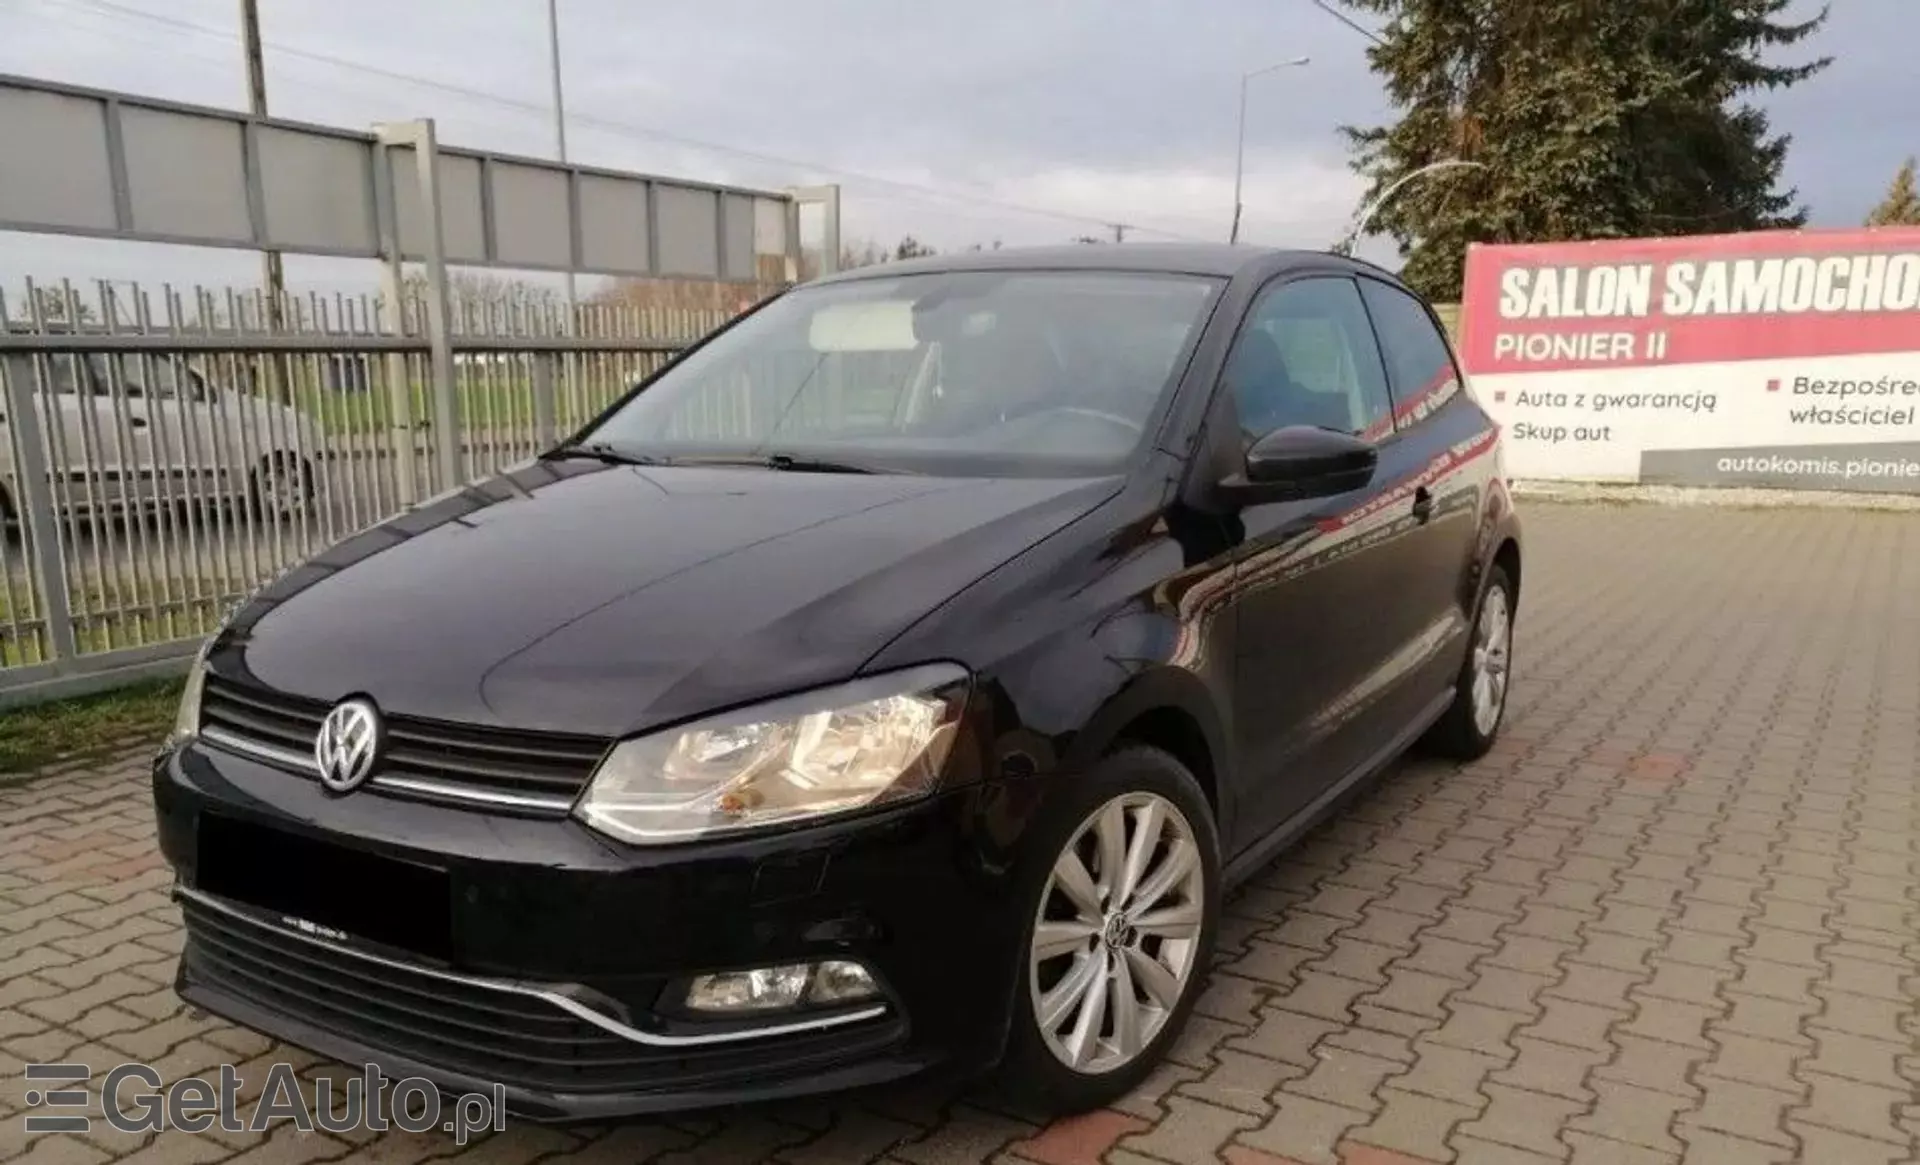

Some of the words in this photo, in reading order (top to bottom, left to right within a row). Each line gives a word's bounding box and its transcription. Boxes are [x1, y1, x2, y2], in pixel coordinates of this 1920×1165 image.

[1500, 265, 1653, 318] SALON
[1662, 253, 1920, 316] SAMOCHO
[1494, 332, 1636, 361] PIONIER
[1792, 375, 1920, 401] Bezpośre
[1515, 389, 1568, 408] Auta
[1574, 392, 1586, 408] z
[1592, 389, 1718, 413] gwarancją
[1789, 405, 1916, 426] właściciel
[1512, 421, 1567, 444] Skup
[1573, 424, 1611, 442] aut
